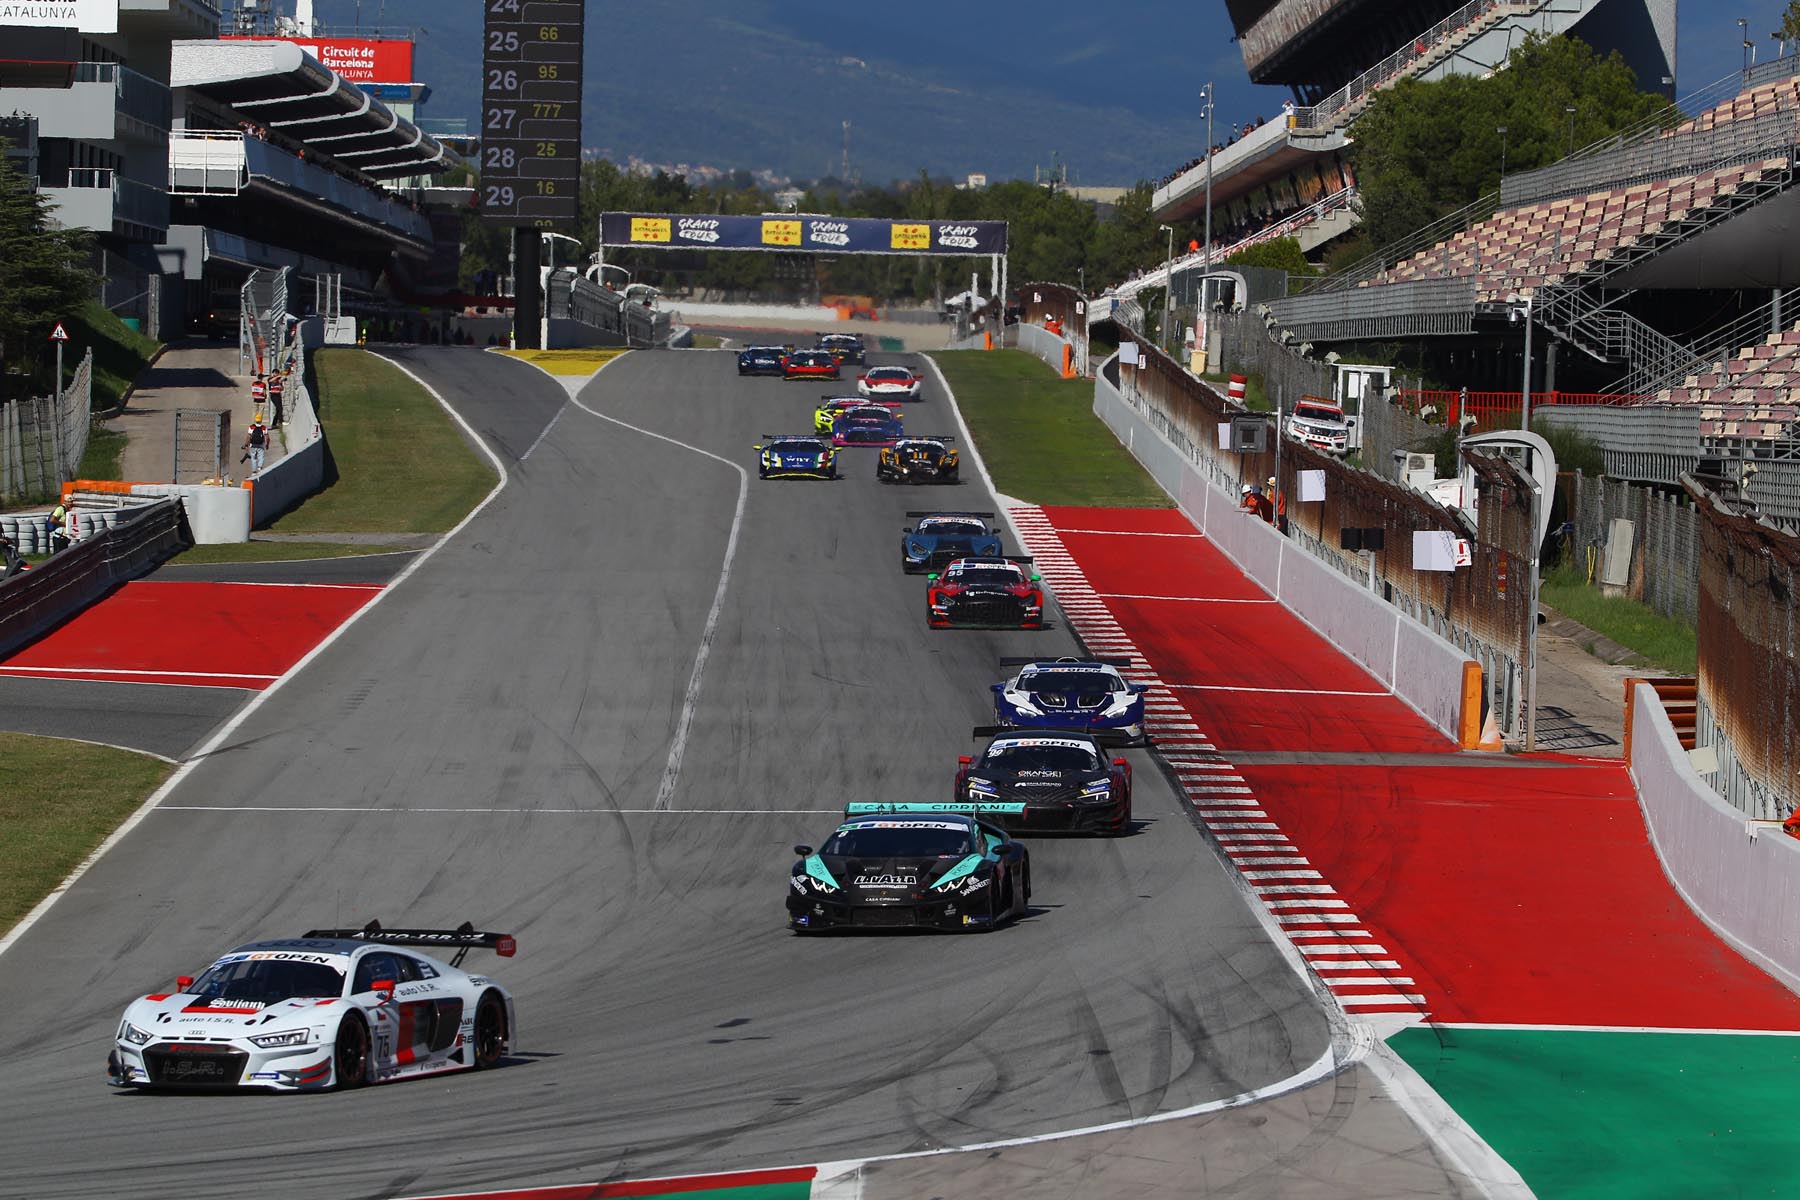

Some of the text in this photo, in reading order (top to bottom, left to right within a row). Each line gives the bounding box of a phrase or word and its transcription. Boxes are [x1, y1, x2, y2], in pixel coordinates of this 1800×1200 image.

[490, 0, 520, 13] 24
[540, 26, 559, 40] 66
[489, 31, 519, 51] 25
[322, 46, 375, 58] Circuit de
[322, 57, 374, 69] Barcelona
[331, 69, 374, 79] TALUNYA
[538, 65, 558, 79] 95
[488, 69, 518, 90] 26
[532, 103, 562, 118] 777
[487, 108, 517, 129] 27
[536, 142, 557, 157] 25
[486, 147, 515, 168] 28
[535, 180, 555, 195] 16
[486, 186, 514, 206] 29
[678, 218, 720, 230] GRAND
[809, 221, 849, 232] GRAND
[939, 224, 978, 236] GRAND
[683, 230, 714, 241] TOUR
[943, 236, 972, 247] TOUR
[854, 874, 917, 885] LAVAZZA
[376, 1034, 391, 1058] 75
